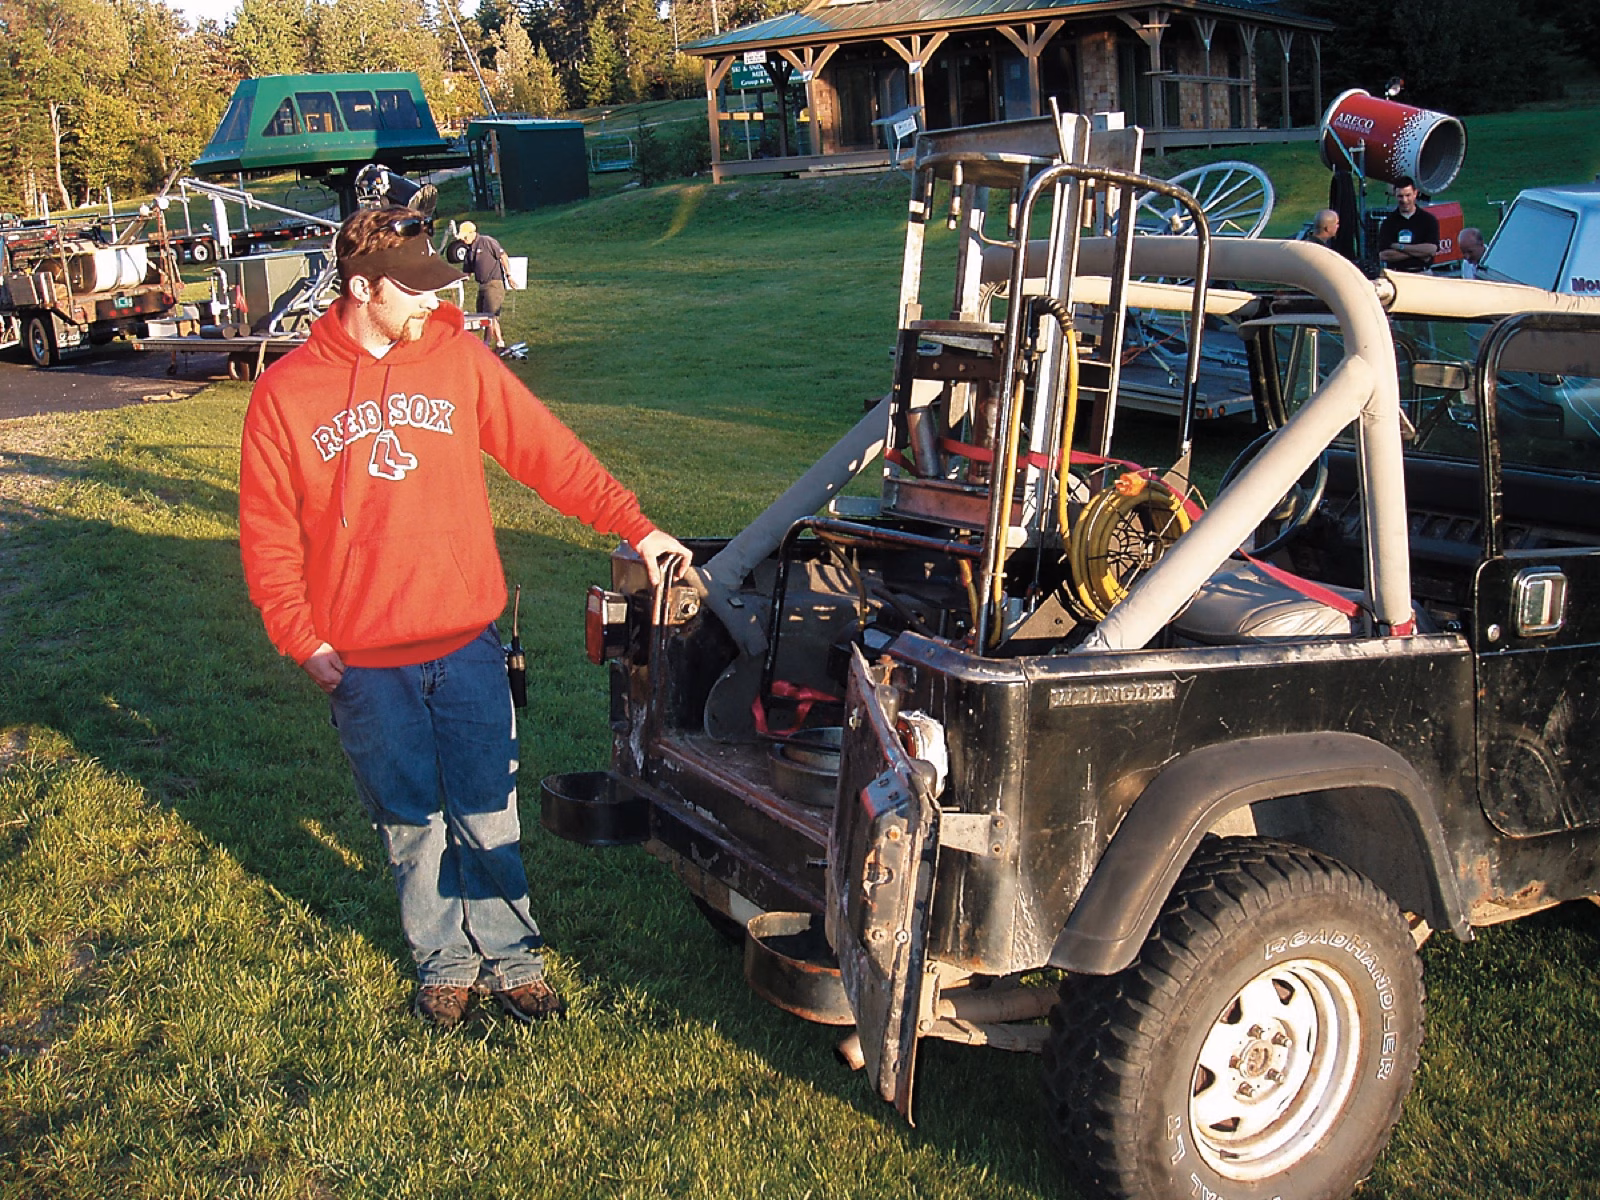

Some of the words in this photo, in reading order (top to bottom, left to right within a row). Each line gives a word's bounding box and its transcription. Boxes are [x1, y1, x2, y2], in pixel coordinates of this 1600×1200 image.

[1335, 112, 1374, 129] ARECO
[312, 401, 382, 462] RED
[388, 392, 455, 435] SOX
[1050, 681, 1176, 707] WRANGLER
[1264, 928, 1397, 1080] ROADHANDLER
